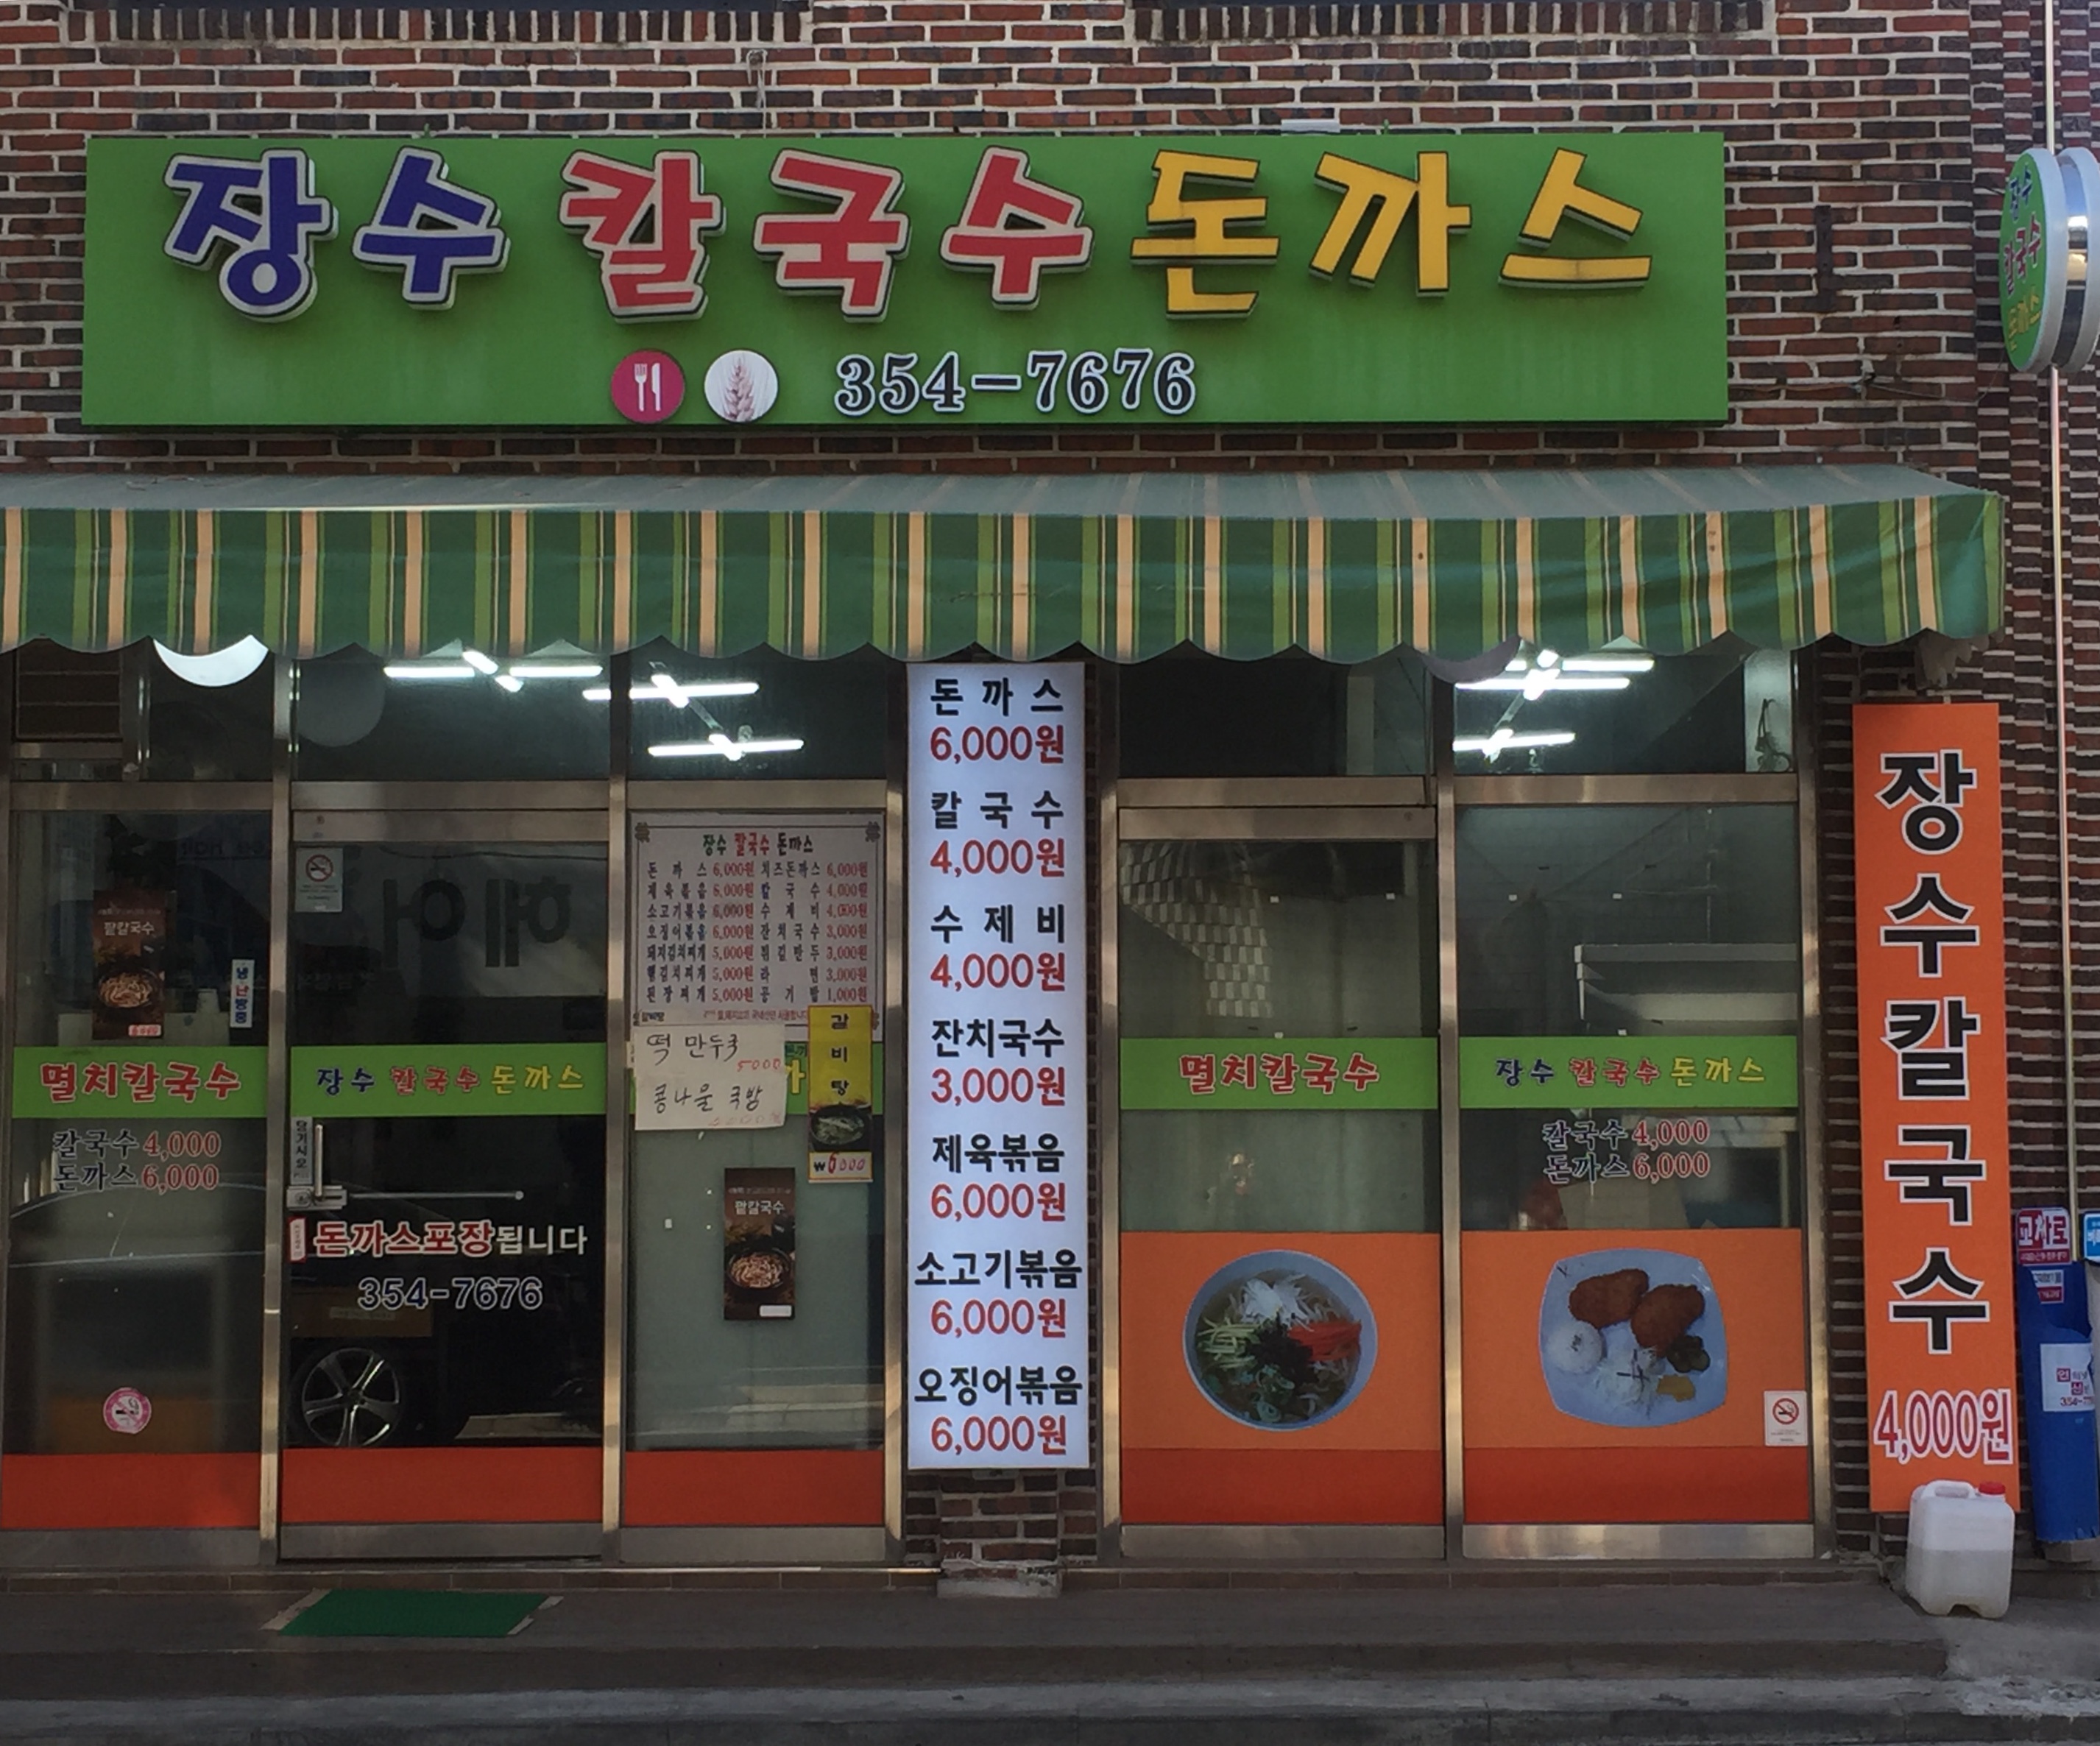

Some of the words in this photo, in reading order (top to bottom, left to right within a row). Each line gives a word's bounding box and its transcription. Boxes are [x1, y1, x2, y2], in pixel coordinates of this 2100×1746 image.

[163, 146, 512, 322] 장수
[559, 146, 1093, 322] 칼국수
[1130, 148, 1652, 319] 돈까스
[835, 348, 1197, 416] 354-7676
[930, 724, 1064, 764] 6,000원
[703, 833, 726, 856] 장수
[735, 833, 770, 856] 칼국수
[777, 832, 813, 856] 돈까스
[930, 838, 1065, 877] 4,000원
[713, 861, 754, 879] 6,000원
[930, 952, 1066, 992] 4,000원
[647, 1033, 671, 1066] 떡
[685, 1033, 739, 1061] 만두국
[830, 1014, 849, 1096] 갈비탕
[932, 1018, 1065, 1058] 잔치국수
[40, 1062, 241, 1103] 멸치칼국수
[317, 1067, 375, 1096] 장수
[390, 1066, 481, 1095] 칼국수
[491, 1064, 585, 1095] 돈까스
[737, 1058, 782, 1072] 5000
[1178, 1051, 1380, 1095] 멸치칼국수
[1496, 1058, 1555, 1087] 장수
[1569, 1057, 1661, 1086] 칼국수
[1670, 1056, 1766, 1087] 돈까스
[931, 1067, 1066, 1106] 3,000원
[53, 1129, 140, 1159] 칼국수
[143, 1131, 221, 1162] 4,000
[932, 1134, 1065, 1173] 제육볶음
[1541, 1120, 1627, 1152] 칼국수
[1631, 1118, 1711, 1150] 4,000
[53, 1163, 138, 1192] 돈까스
[141, 1164, 219, 1195] 6,000
[1544, 1151, 1630, 1184] 돈까스
[1632, 1151, 1711, 1184] 6,000
[930, 1182, 1066, 1222] 6,000원
[2019, 1215, 2068, 1246] 교차로
[914, 1249, 1083, 1290] 소고기볶음
[358, 1276, 543, 1310] 354-7676
[930, 1299, 1067, 1339] 6,000원
[914, 1365, 1083, 1407] 오징어볶음
[931, 1415, 1067, 1456] 6,000원
[1873, 1389, 2013, 1465] 4,000원
